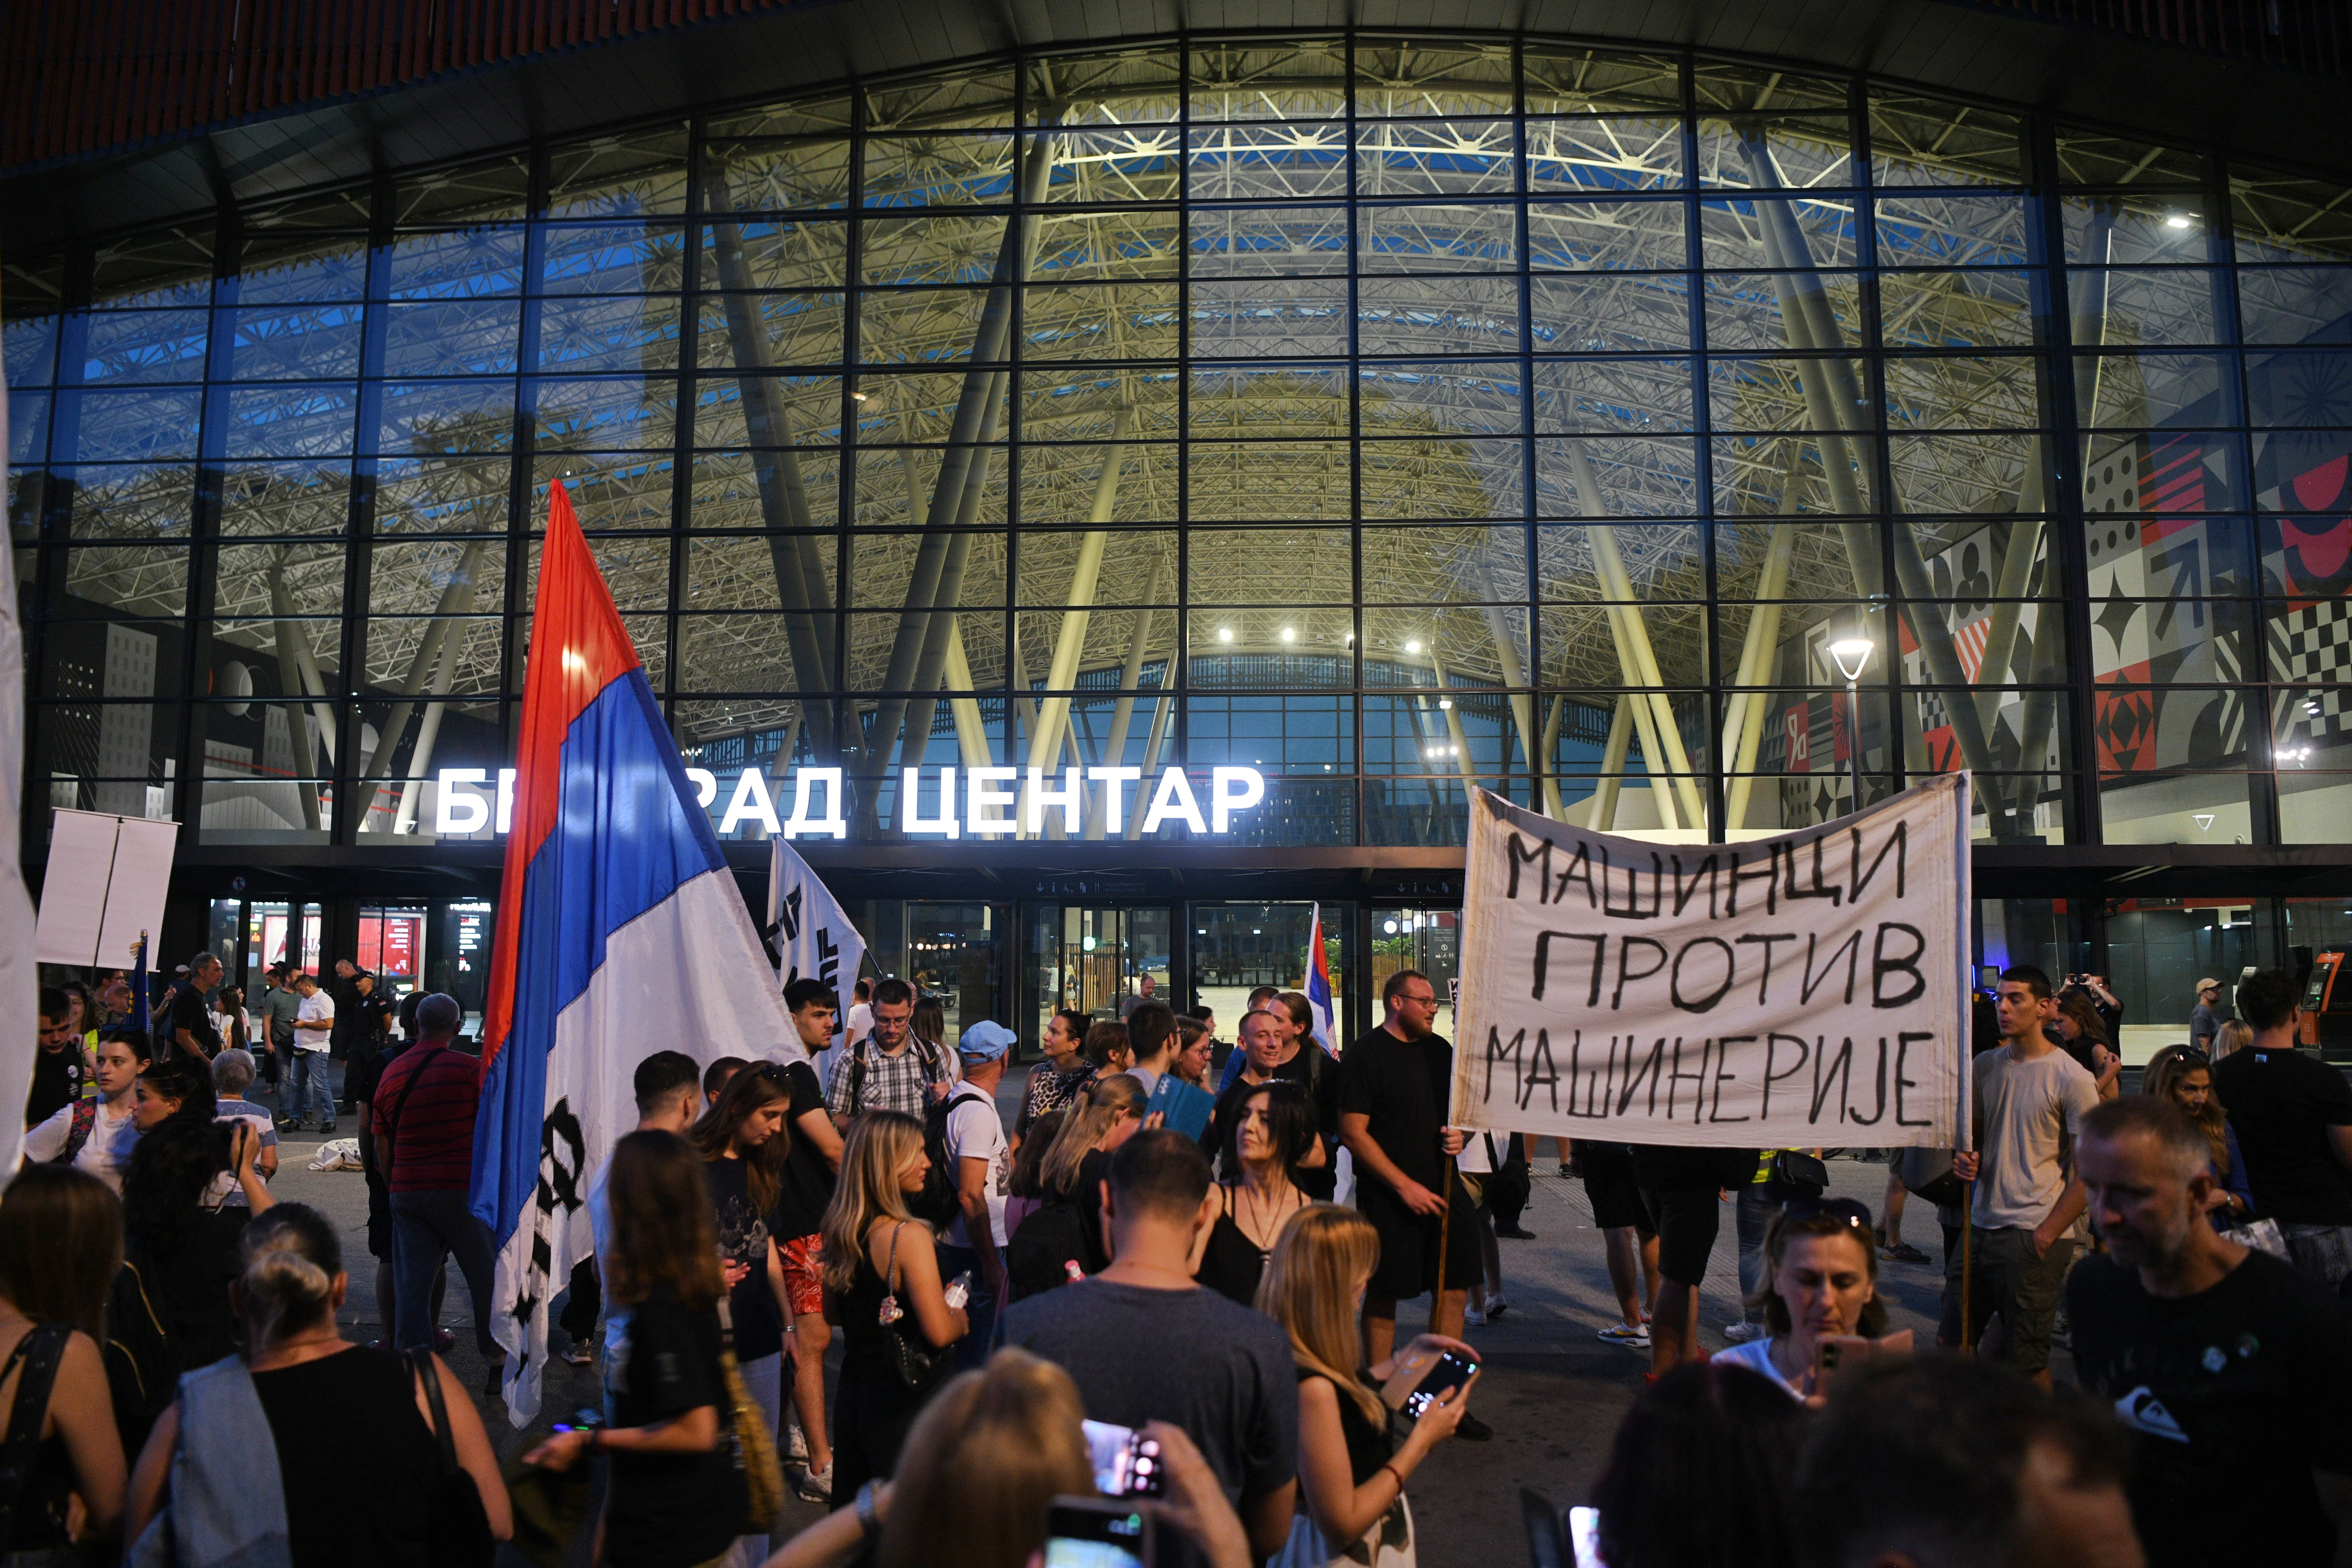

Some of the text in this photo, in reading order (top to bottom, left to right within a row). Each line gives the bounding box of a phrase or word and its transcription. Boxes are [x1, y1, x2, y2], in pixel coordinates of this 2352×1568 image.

[903, 767, 1265, 838] ЦЕНТАР
[1507, 820, 1907, 920] МАШИНЦИ
[1532, 922, 1926, 1014] ПРОТИВ
[1483, 1024, 1934, 1127] МАШИНЕРИЈЕ
